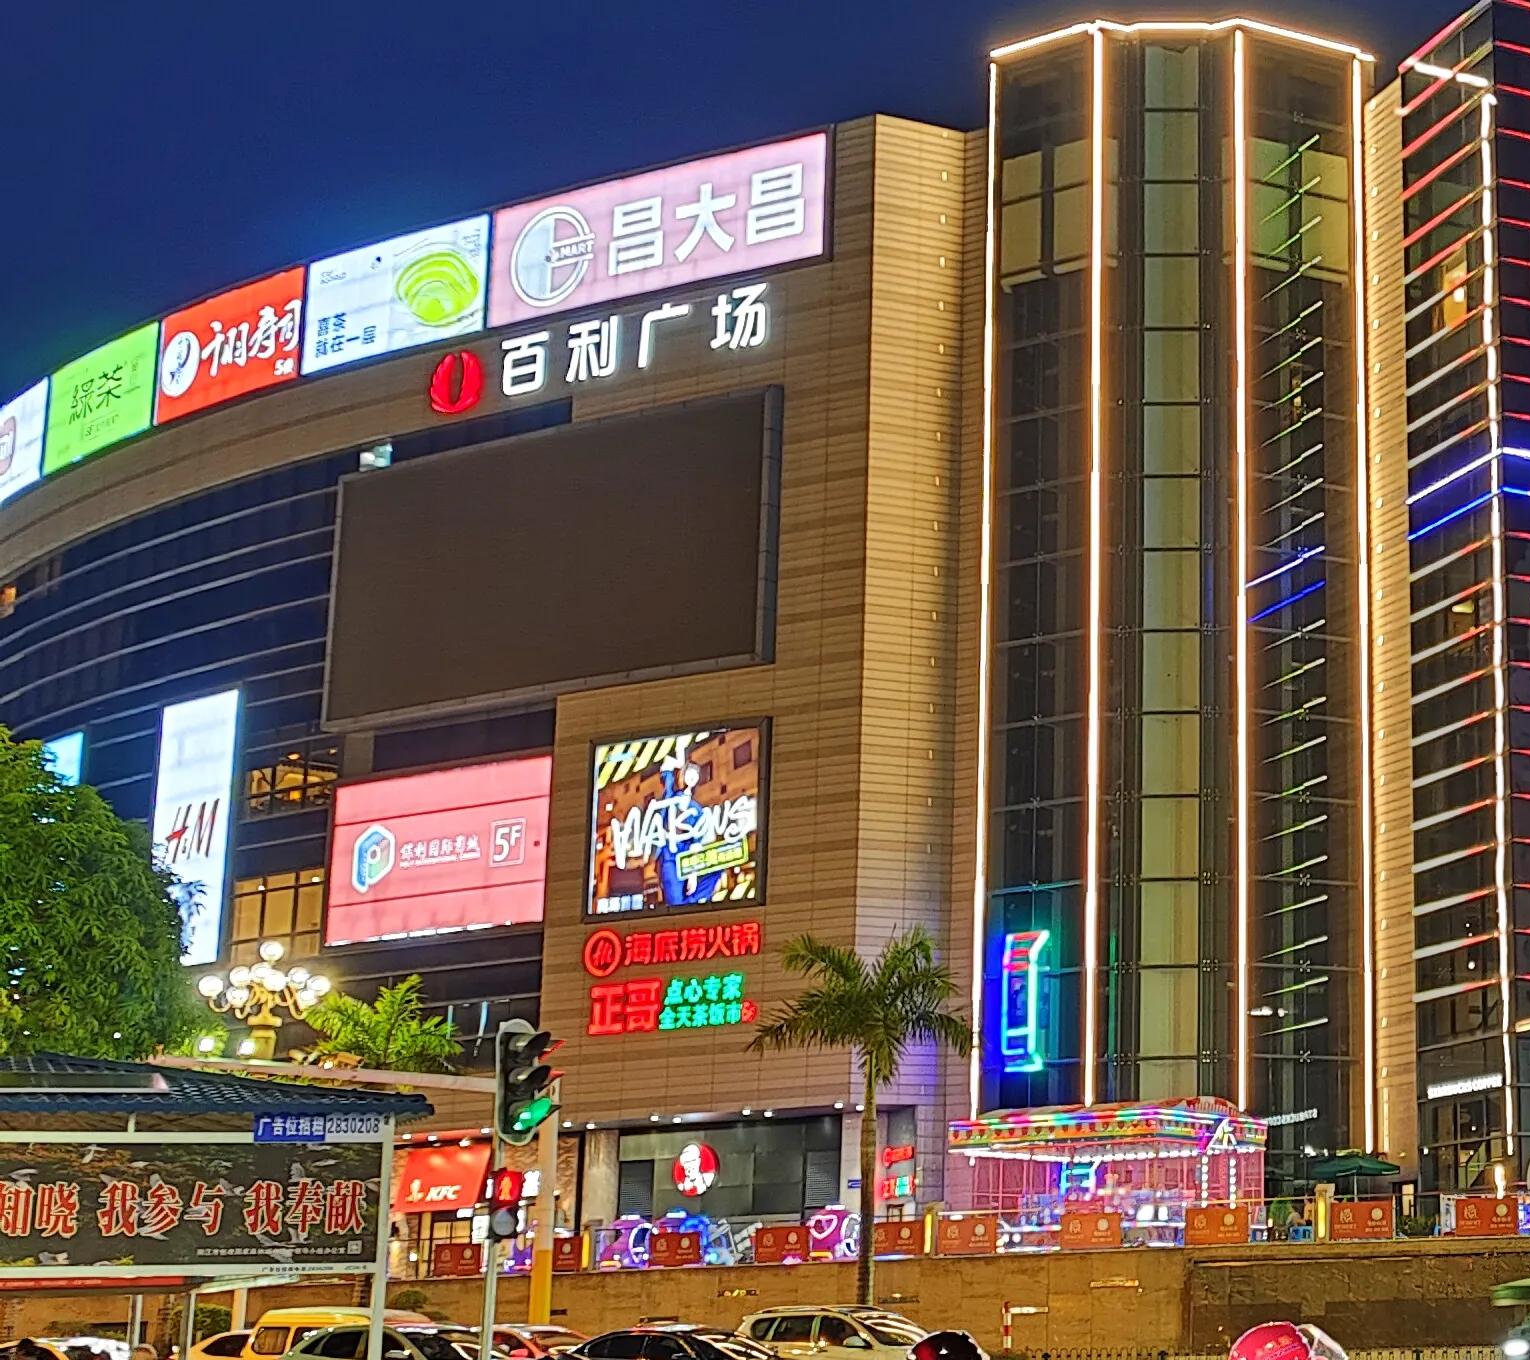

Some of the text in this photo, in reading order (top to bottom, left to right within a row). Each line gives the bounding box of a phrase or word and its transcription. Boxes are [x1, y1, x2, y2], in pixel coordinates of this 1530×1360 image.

[608, 163, 805, 276] 昌大昌
[501, 282, 772, 397] 百利广场
[493, 824, 522, 862] 5F
[624, 922, 760, 966] 海底捞火锅
[588, 979, 662, 1036] 正哥
[664, 973, 743, 1006] 点心专家
[327, 1117, 380, 1134] 2830208
[0, 1179, 367, 1238] 知晓 我参与 我奉献
[426, 1184, 462, 1202] KFC
